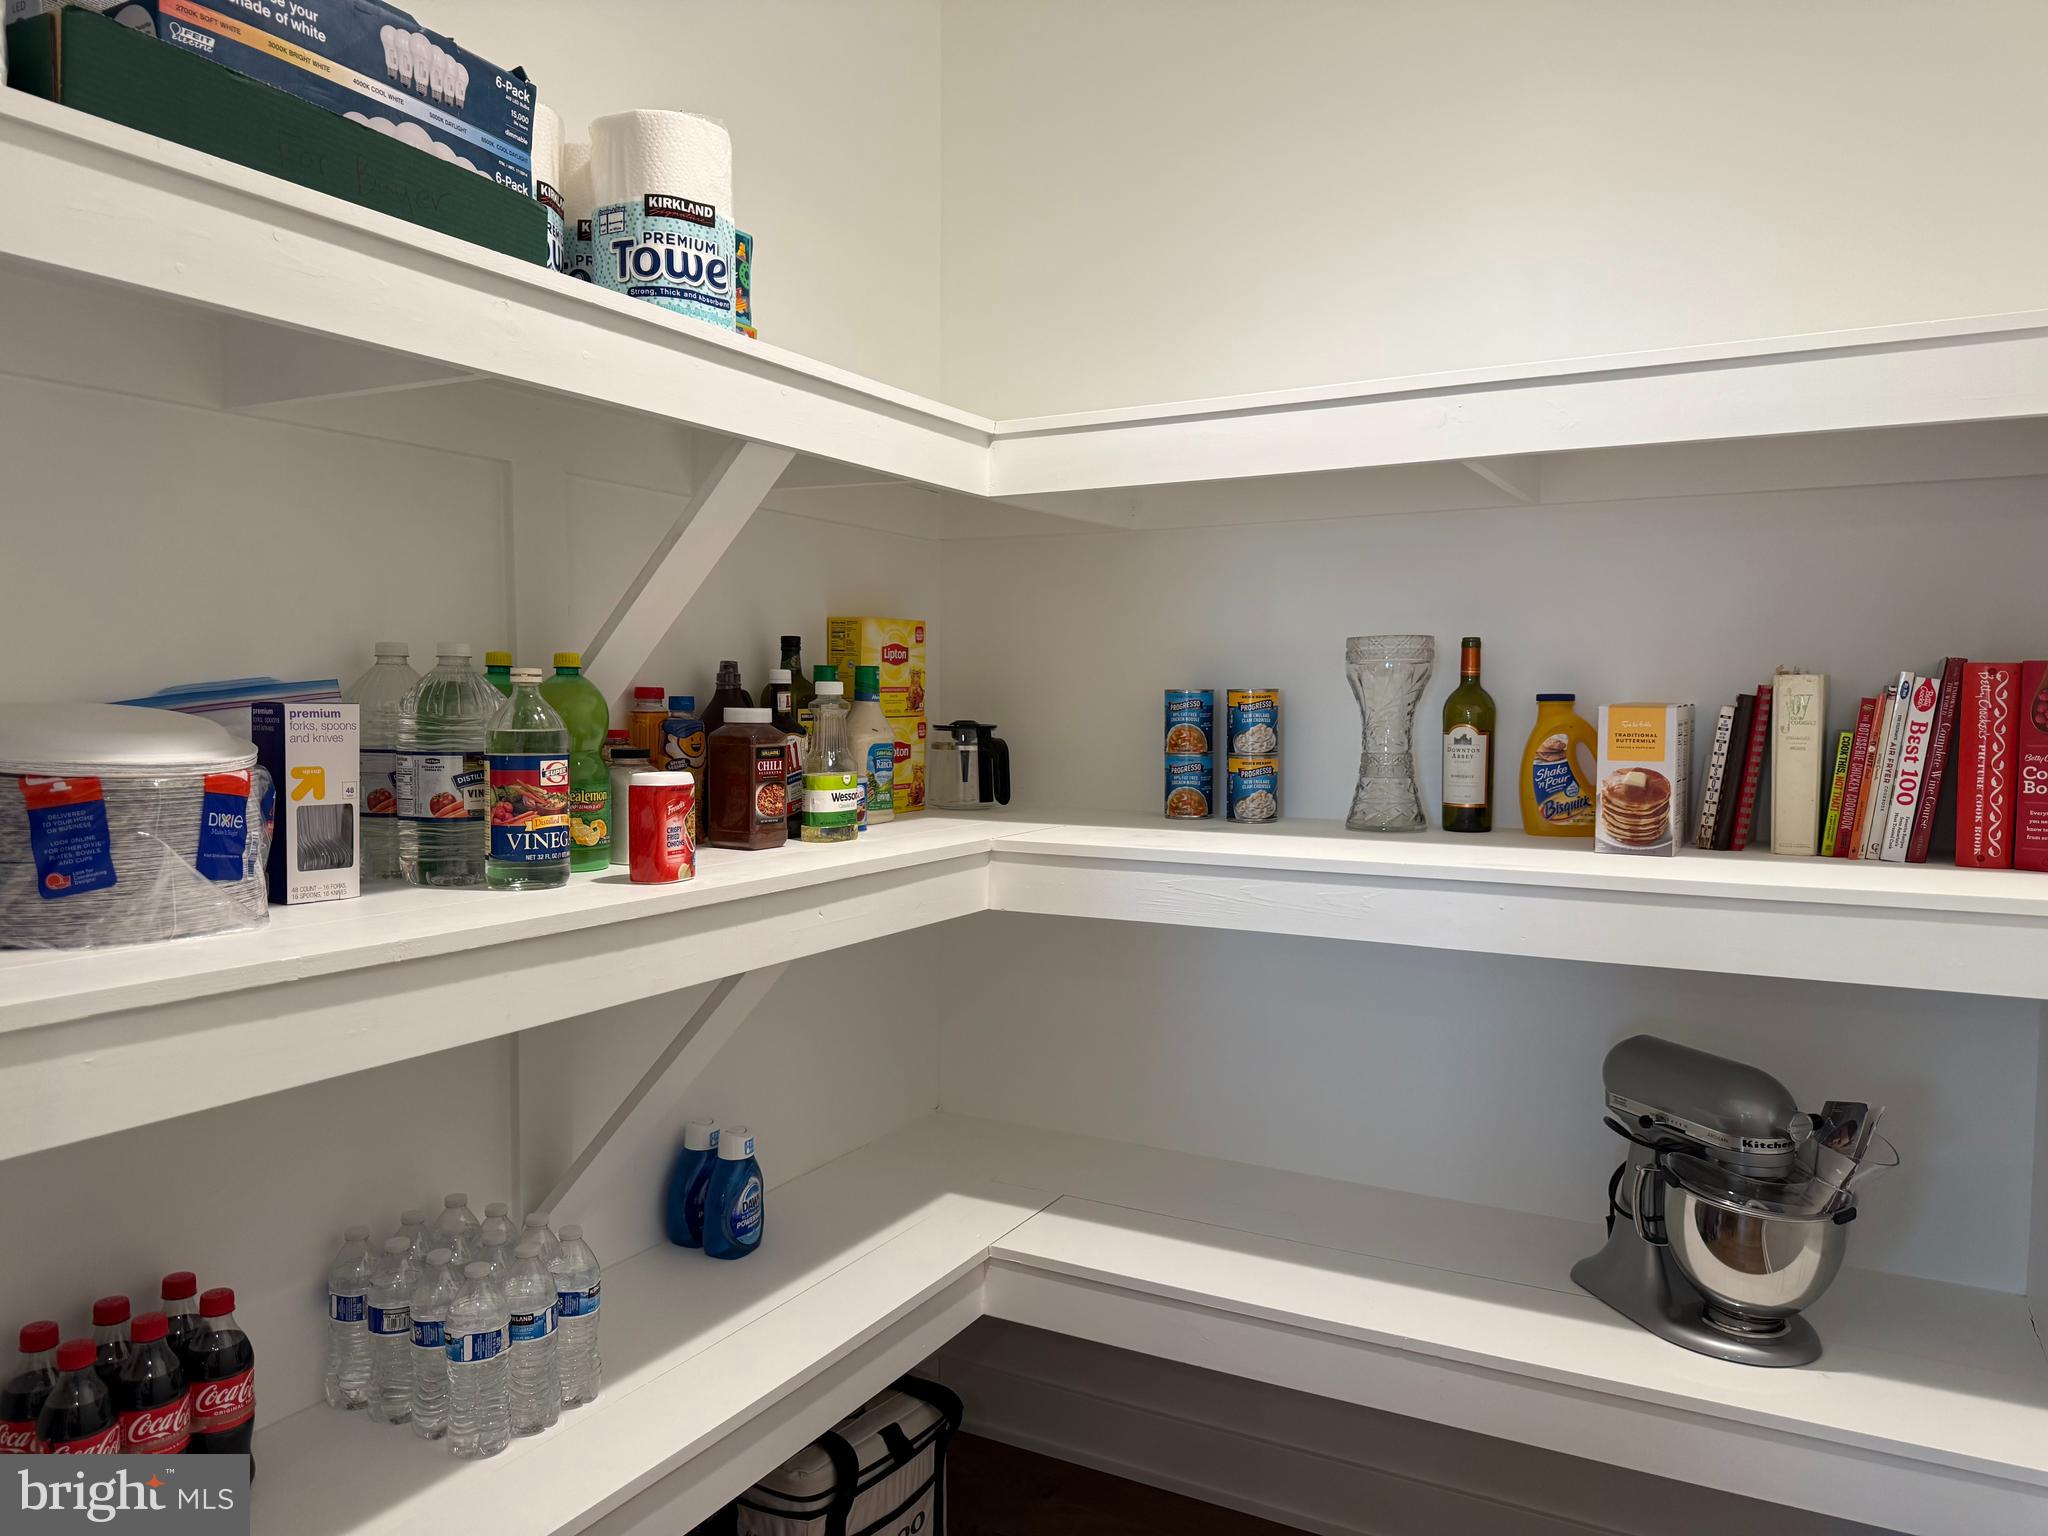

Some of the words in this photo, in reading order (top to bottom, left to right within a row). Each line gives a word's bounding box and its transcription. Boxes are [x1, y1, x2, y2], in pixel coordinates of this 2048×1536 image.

[176, 4, 198, 18] 2700K
[199, 12, 217, 25] SOFT
[220, 21, 241, 35] WHITE
[289, 2, 318, 22] your
[275, 12, 288, 26] of
[290, 19, 326, 42] white
[172, 35, 213, 53] electric
[289, 49, 311, 64] BRIGHT
[312, 60, 331, 73] WHITE
[353, 78, 370, 92] 4000K
[371, 86, 387, 98] COOL
[388, 93, 405, 106] WHITE
[495, 76, 530, 104] 6-Pack
[511, 109, 529, 125] 15,000
[445, 119, 467, 134] DAYLIGHT
[505, 129, 528, 145] dimmable
[495, 171, 529, 197] 6-Pack
[541, 184, 564, 210] KIRKL
[648, 196, 713, 218] KIRKLAND
[643, 232, 716, 255] PREMIUM
[612, 240, 728, 290] Towe
[660, 288, 681, 297] Thick
[683, 290, 697, 299] and
[699, 295, 729, 309] Absorbent
[884, 648, 907, 661] Lipton
[1976, 672, 1993, 697] Betty
[1170, 700, 1200, 711] PROGRESSO
[1917, 686, 1928, 710] Crocker
[1925, 689, 1934, 707] Betty
[289, 709, 341, 720] premium
[1241, 701, 1272, 712] PROGRESSO
[290, 721, 318, 731] forks,
[321, 722, 357, 733] spoons
[290, 734, 309, 743] and
[313, 734, 344, 743] knives
[1839, 736, 1851, 756] COOK
[1854, 723, 1870, 761] ROTISSERIE
[1933, 723, 1951, 768] Complete
[1888, 742, 1897, 756] AIR
[757, 761, 783, 771] CHILI
[876, 760, 893, 768] Ranch
[2025, 754, 2043, 763] Betty
[545, 767, 567, 778] SUPER
[1171, 763, 1201, 774] PROGRESSO
[1241, 767, 1272, 778] PROGRESSO
[1535, 765, 1567, 781] Shake
[1884, 759, 1895, 784] FRYER
[1976, 745, 1986, 789] PICTURE
[2023, 766, 2048, 780] Co
[457, 773, 484, 784] DISTILL
[1544, 775, 1570, 789] Pour
[1833, 776, 1845, 791] NOT
[1848, 762, 1863, 792] CHICKEN
[1928, 771, 1943, 794] Wine
[467, 789, 484, 798] VIN
[1896, 769, 1919, 806] 100
[2023, 780, 2048, 794] Bo
[570, 790, 608, 804] eaLemon
[48, 810, 86, 820] DELIVERED
[1545, 796, 1591, 818] Bisquick
[1841, 794, 1857, 831] COOKBOOK
[1921, 798, 1936, 829] Course
[1975, 794, 1984, 822] COOK
[53, 818, 72, 827] YOUR
[73, 815, 94, 823] HOME
[58, 822, 92, 832] BUSINESS
[535, 817, 560, 828] Distilled
[70, 834, 96, 843] ONLINE
[507, 832, 570, 850] VINEG
[667, 840, 685, 848] ONIONS
[1973, 826, 1982, 855] BOOK
[59, 844, 82, 853] OTHER
[75, 855, 93, 864] CUPS
[214, 1403, 245, 1416] ORIGINAL
